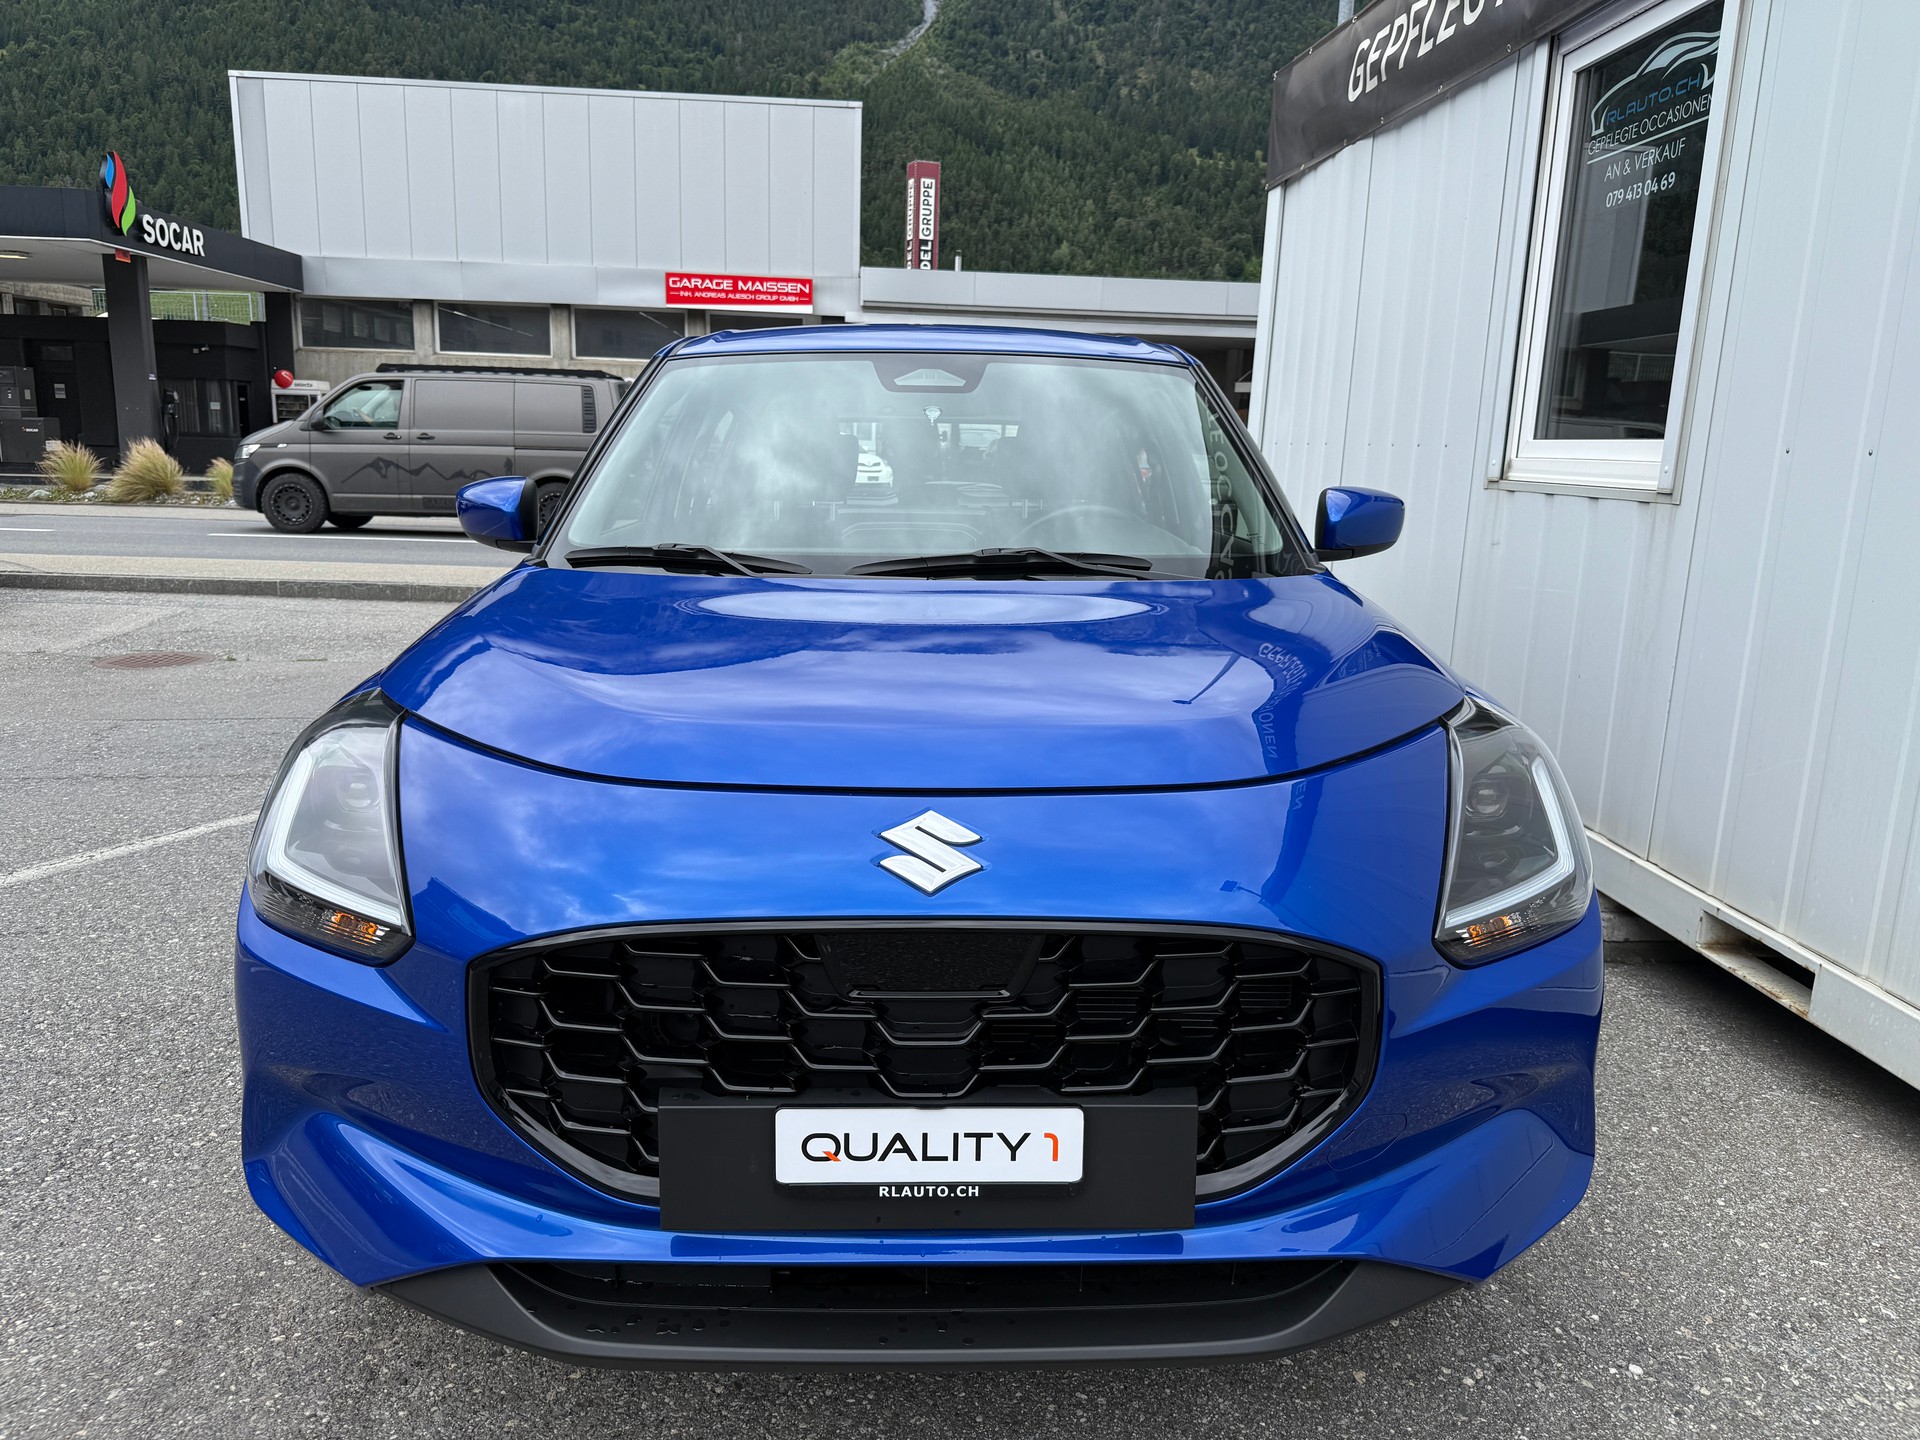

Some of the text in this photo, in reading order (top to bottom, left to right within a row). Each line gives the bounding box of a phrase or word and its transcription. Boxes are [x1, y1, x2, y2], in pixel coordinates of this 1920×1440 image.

[1606, 74, 1701, 125] RLAUTO.CH
[1588, 122, 1640, 156] GEPFLEGTE
[1604, 137, 1687, 182] AN & VERKAUF
[1606, 171, 1676, 208] 079 413 04 69
[921, 180, 933, 237] GRUPPE
[142, 213, 206, 257] SOCAR
[669, 276, 810, 294] GARAGE MAISSEN
[800, 1132, 1059, 1163] QUALITY 1
[878, 1185, 980, 1198] RLAUTO.CH
